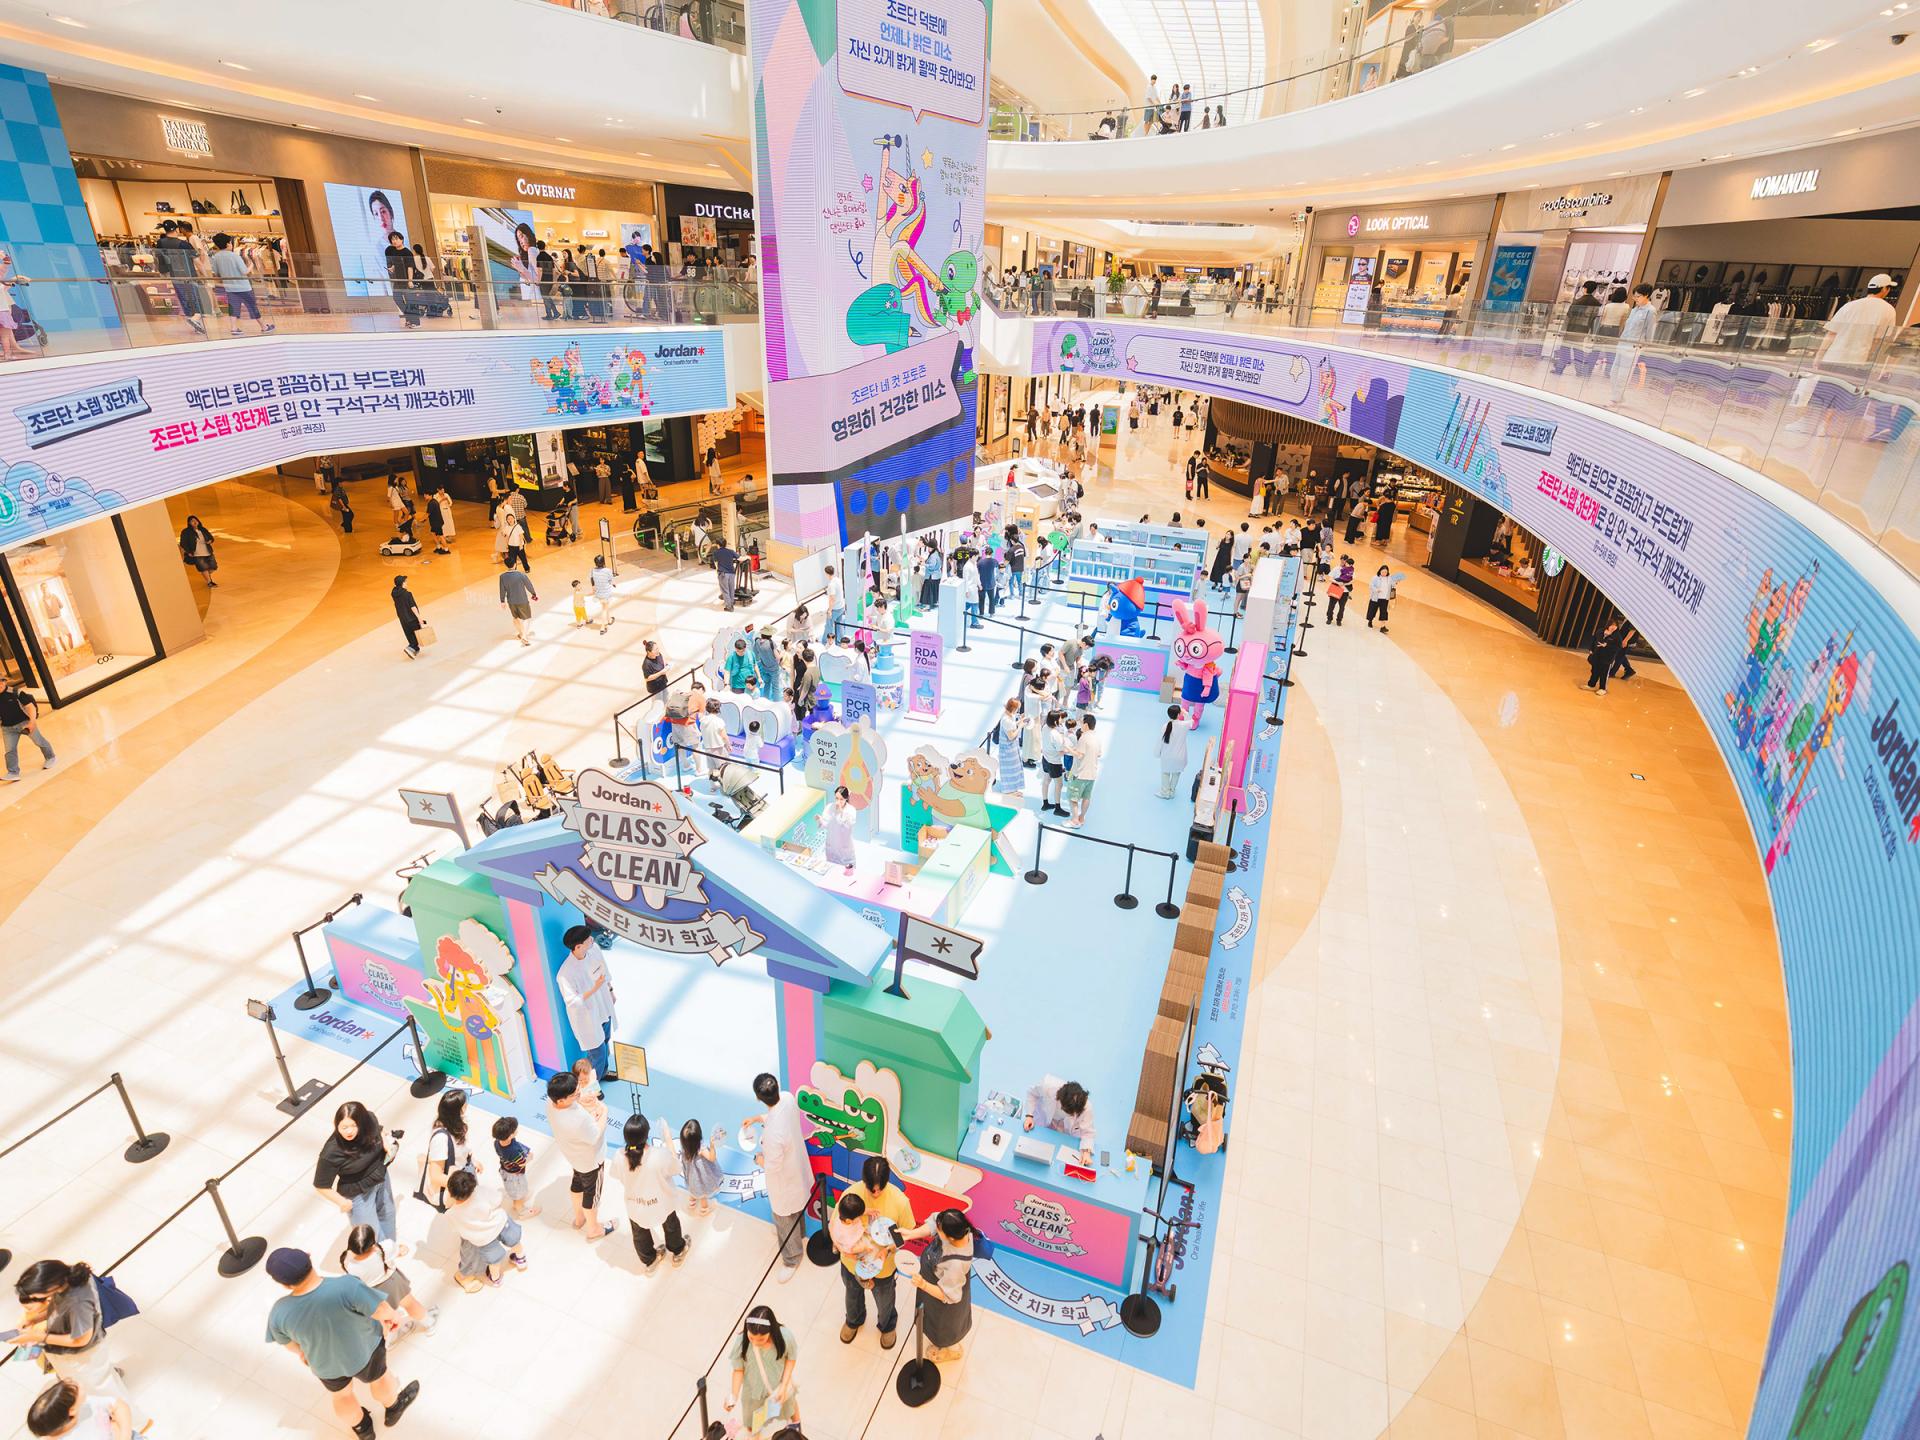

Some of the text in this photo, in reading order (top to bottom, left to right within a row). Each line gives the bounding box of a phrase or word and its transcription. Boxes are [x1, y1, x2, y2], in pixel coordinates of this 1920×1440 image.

[886, 0, 947, 36] 조르단 덕분에
[880, 20, 952, 61] 언제나 밝은 미소
[848, 38, 976, 91] 자신 있게 밝게 활짝 웃어봐요!
[1750, 169, 1820, 200] NOMANUAL
[1366, 215, 1430, 231] LOOK OPTICAL
[1516, 251, 1532, 259] CUT
[654, 344, 698, 358] Jordan
[1092, 337, 1111, 346] CLASS
[1093, 347, 1111, 356] CLEAN
[1179, 347, 1199, 360] 조르단
[1199, 349, 1219, 364] 덕분에
[1219, 352, 1238, 366] 언제나
[1252, 357, 1265, 371] 미소
[1180, 360, 1194, 373] 자신
[1194, 362, 1207, 375] 있게
[1207, 363, 1221, 378] 밝게
[185, 368, 426, 411] 액티브 팁으로 꼼꼼하고 부드럽게
[850, 364, 927, 405] 조르단 네 컷 포토존
[27, 386, 138, 435] 조르단 스텝 3단계
[148, 388, 476, 451] 조르단 스텝 3단계로 입 안 구석구석 깨끗하게!
[831, 379, 947, 442] 영원히 건강한 미소
[1505, 422, 1553, 445] 조르단 스텝 3단계
[1566, 452, 1694, 553] 액티브 팁으로 꼼꼼하고 부드럽게
[1536, 470, 1706, 616] 조르단 스텝 3단계로 입 안 구석구석 깨끗하게!
[96, 652, 115, 665] COS
[915, 647, 938, 659] RDA
[915, 656, 928, 666] 70
[846, 698, 870, 712] PCR
[846, 709, 860, 719] 50
[816, 738, 832, 748] Step
[817, 747, 837, 760] 0-2
[818, 758, 837, 767] YEARS
[1871, 697, 1920, 825] Jordan
[592, 785, 651, 811] Jordan
[585, 812, 695, 848] CLASS OF
[1238, 843, 1251, 872] Jordan
[598, 851, 682, 888] CLEAN
[576, 889, 720, 947] 조르단 치카 학교
[1229, 924, 1247, 939] 조르단
[1240, 911, 1249, 922] 치카
[368, 969, 389, 981] CLASS
[372, 979, 394, 991] CLEAN
[310, 1010, 366, 1037] Jordan
[728, 1179, 754, 1190] 학교
[1023, 1206, 1060, 1222] CLASS
[1030, 1199, 1055, 1210] Jordan
[1026, 1218, 1064, 1234] CLEAN
[1014, 1229, 1036, 1244] 조르단
[1037, 1240, 1053, 1250] 치카
[985, 1270, 1090, 1320] 조르단 치카 학교
